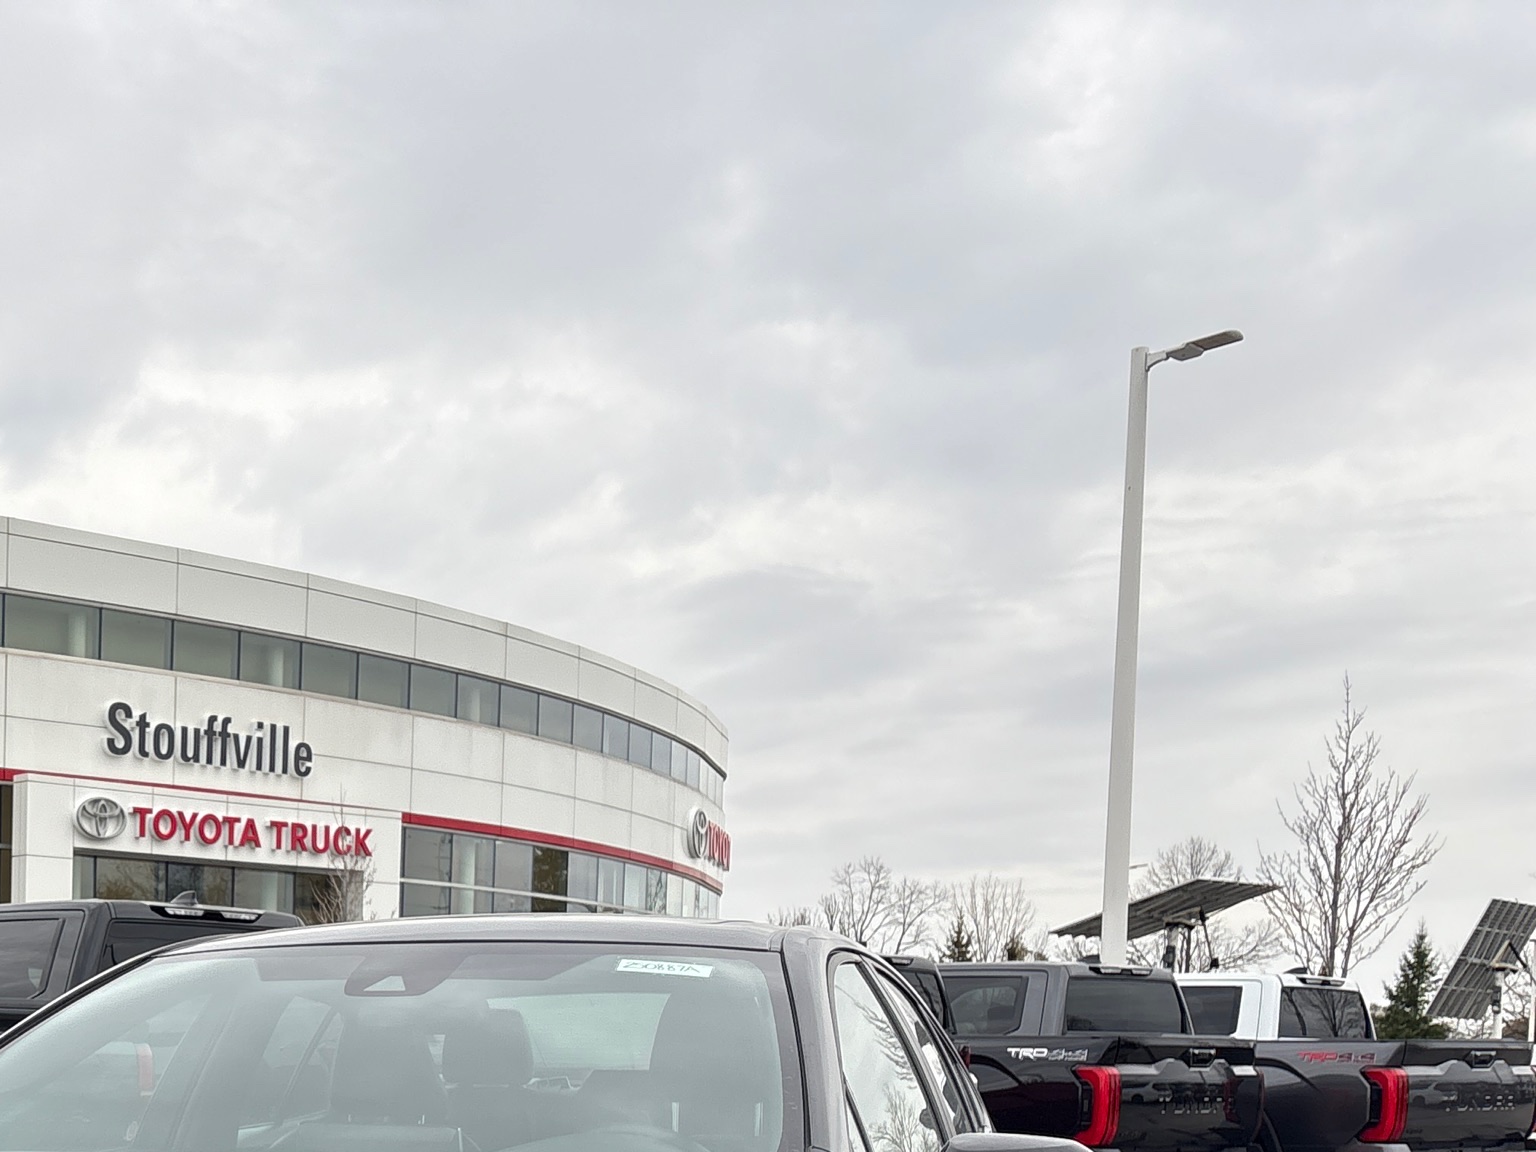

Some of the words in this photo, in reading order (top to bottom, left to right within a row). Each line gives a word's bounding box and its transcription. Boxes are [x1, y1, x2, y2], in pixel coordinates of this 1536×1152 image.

[105, 701, 313, 778] Stouffville
[132, 806, 262, 849] TOYOTA
[268, 820, 373, 857] TRUCK
[1006, 1047, 1048, 1060] TRD
[1296, 1050, 1338, 1063] TRD
